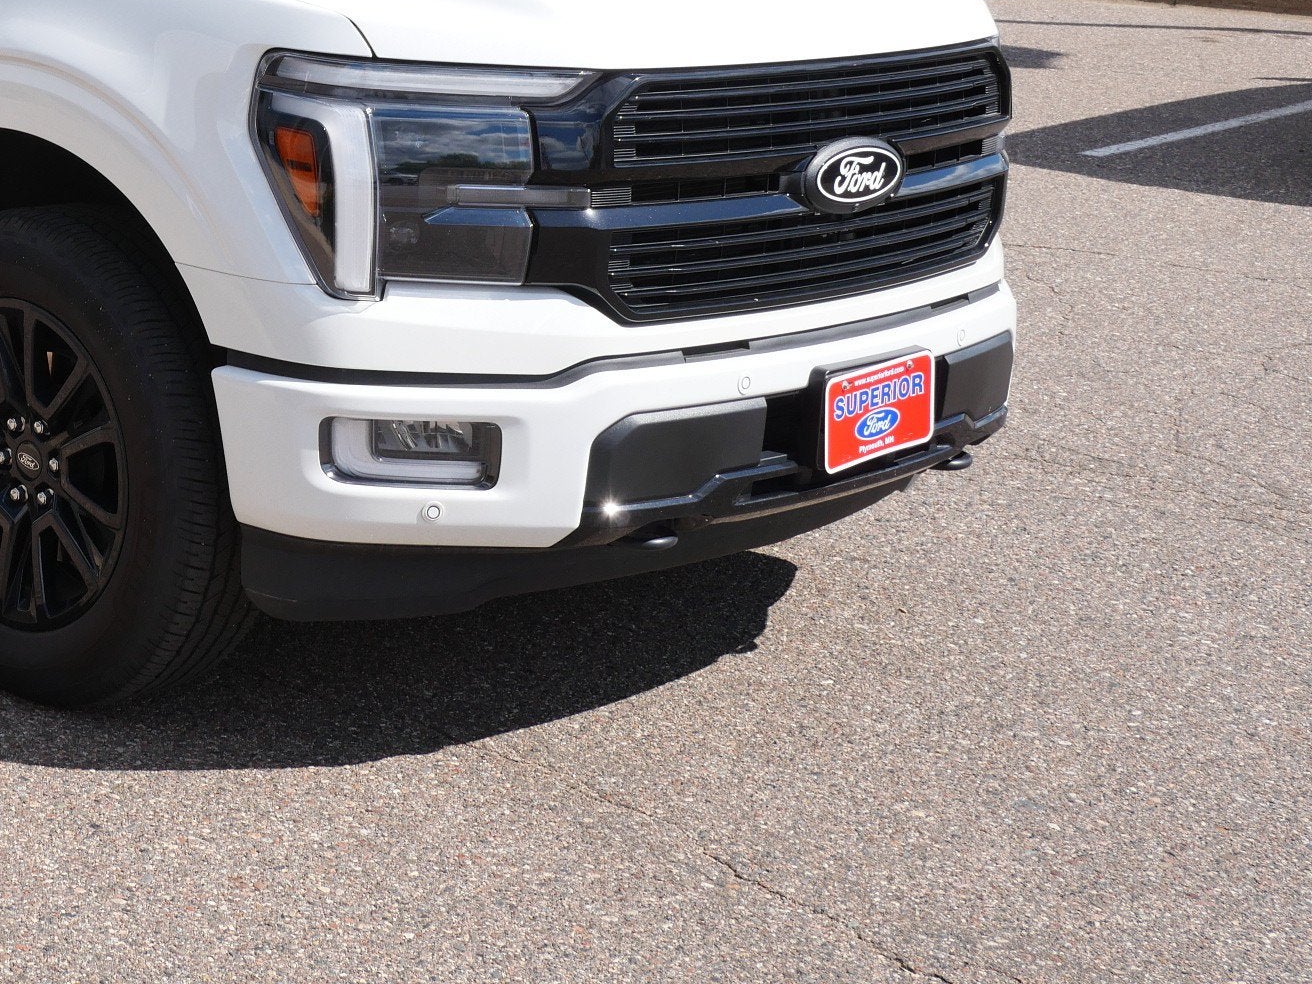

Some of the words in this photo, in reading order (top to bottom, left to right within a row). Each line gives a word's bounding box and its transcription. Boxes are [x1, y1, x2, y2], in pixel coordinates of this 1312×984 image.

[833, 155, 887, 195] Ford
[833, 372, 925, 421] SUPERIOR
[863, 412, 892, 436] Ford
[859, 439, 885, 454] Plymouth,
[884, 435, 895, 445] MN
[20, 454, 36, 468] Ford
